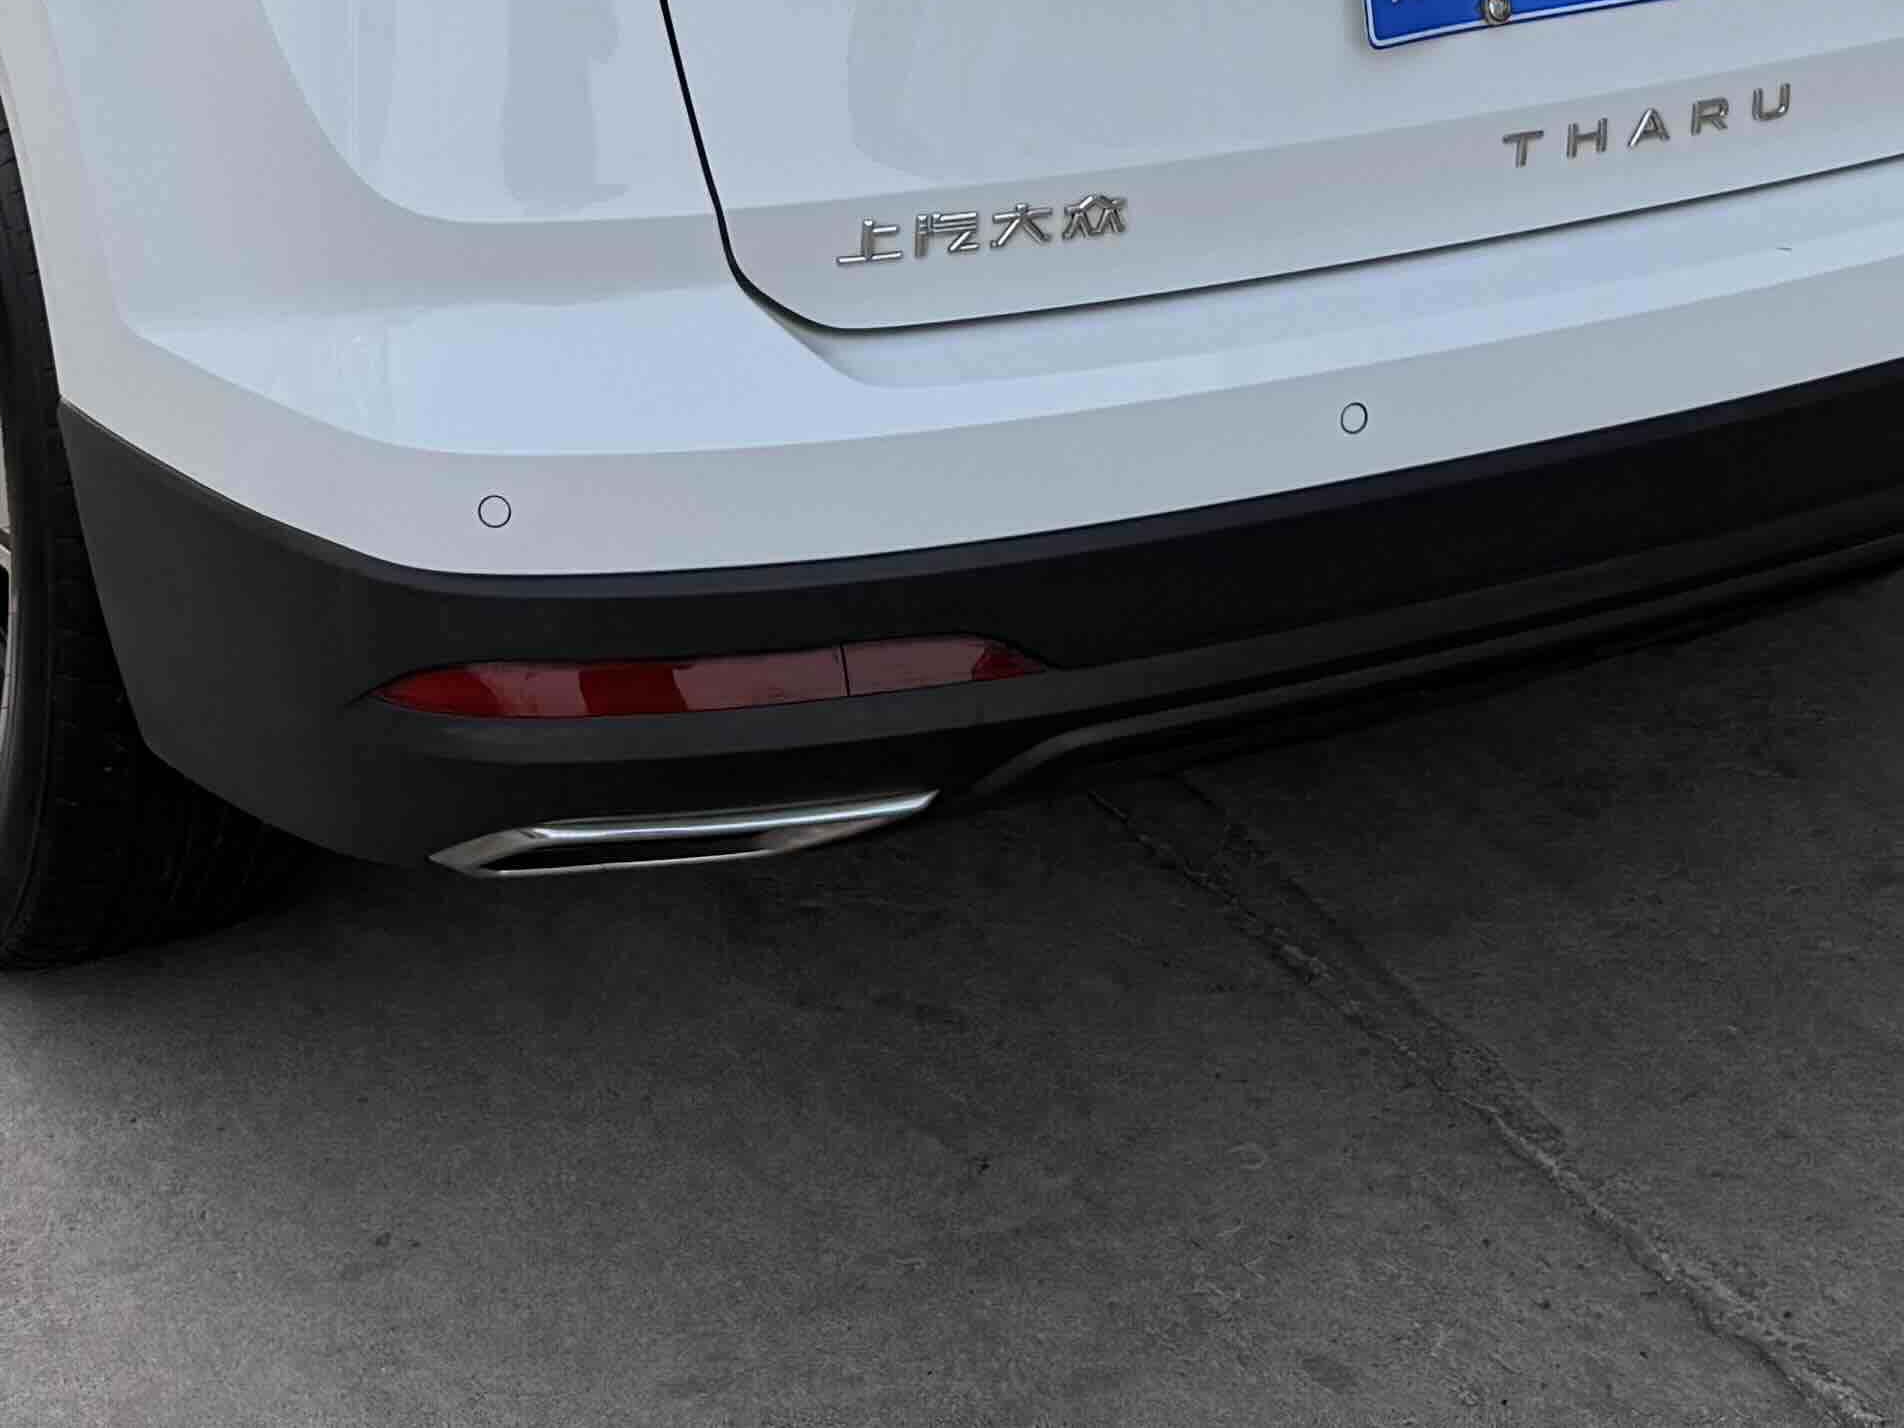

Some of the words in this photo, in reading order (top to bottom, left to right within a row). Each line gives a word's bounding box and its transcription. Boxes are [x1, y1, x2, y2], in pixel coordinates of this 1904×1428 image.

[1502, 81, 1794, 169] THARU
[836, 193, 1129, 265] 上汽大众
